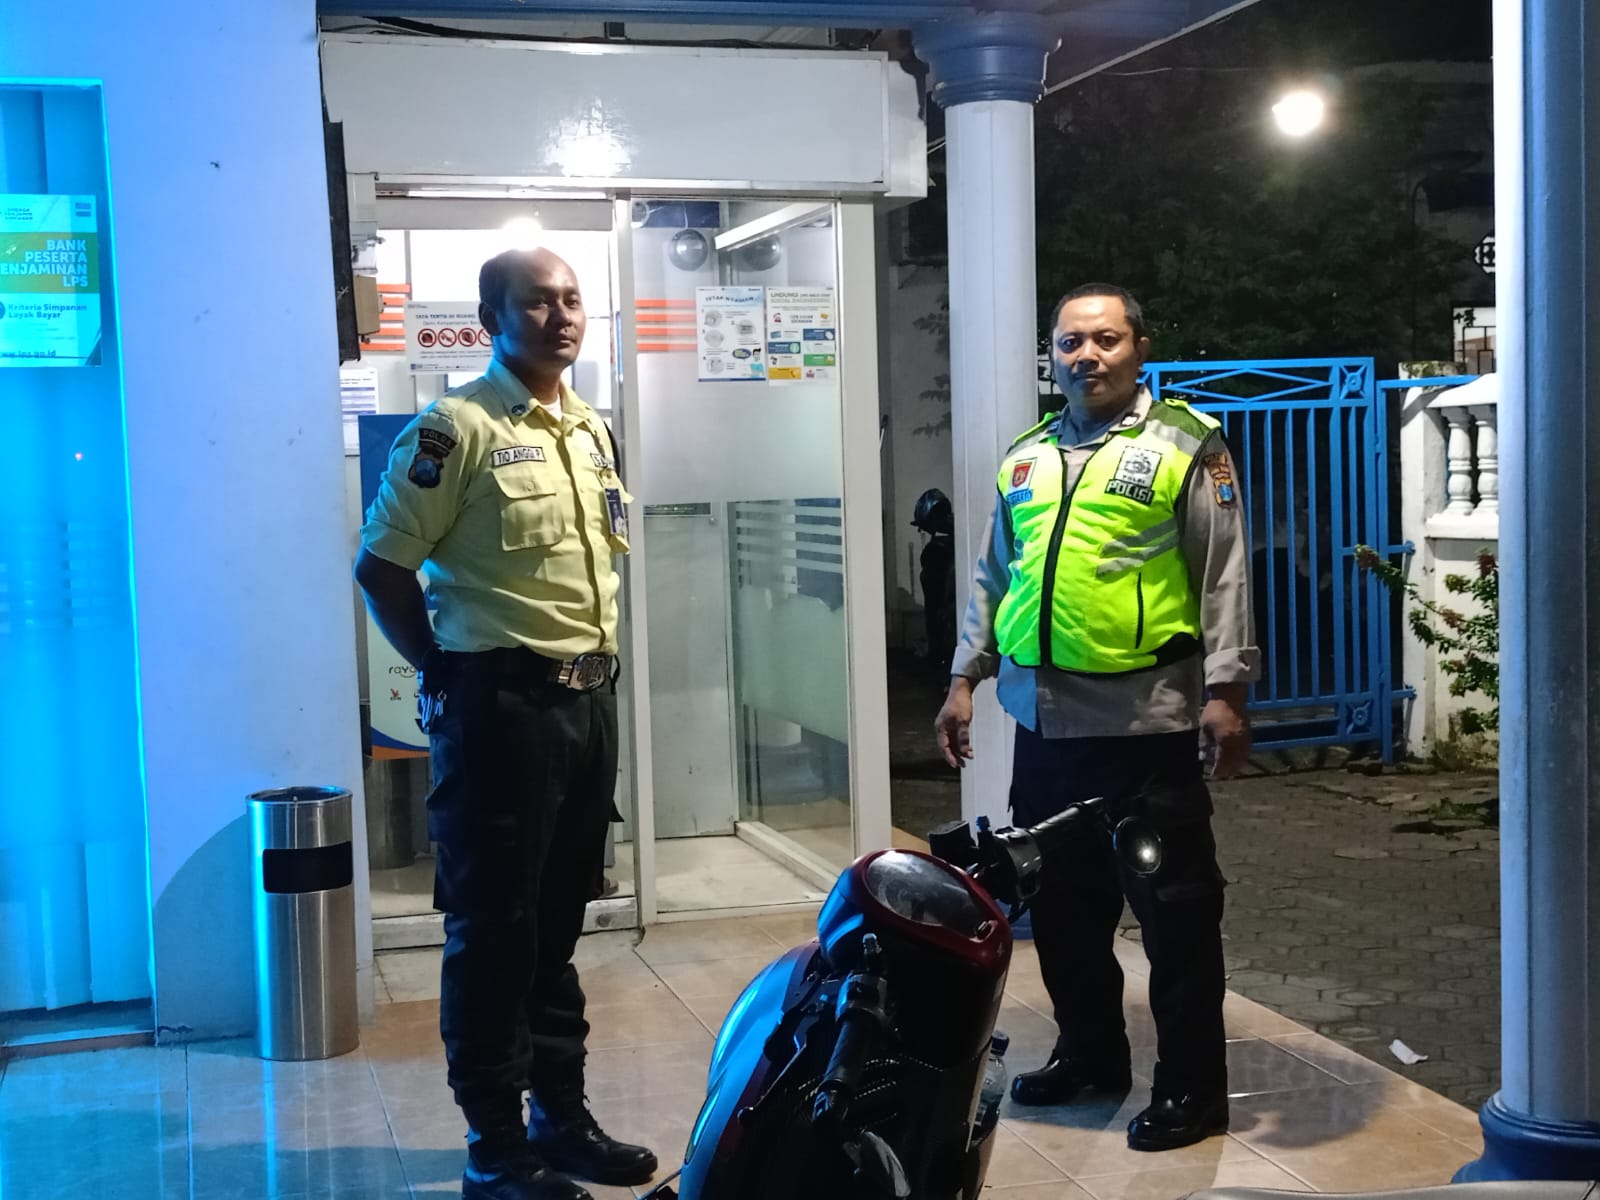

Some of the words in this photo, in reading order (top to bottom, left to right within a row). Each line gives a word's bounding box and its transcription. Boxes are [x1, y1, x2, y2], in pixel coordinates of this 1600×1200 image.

[46, 239, 87, 251] BANK
[25, 251, 87, 263] PESERTA
[0, 263, 87, 275] ENJAMINAN
[62, 275, 88, 287] LPS
[8, 303, 42, 311] Kriteria
[43, 303, 87, 313] Simpanan
[8, 311, 34, 320] Layak
[36, 311, 61, 320] Bayar
[497, 450, 511, 464] TIO
[1106, 480, 1153, 503] POLISI
